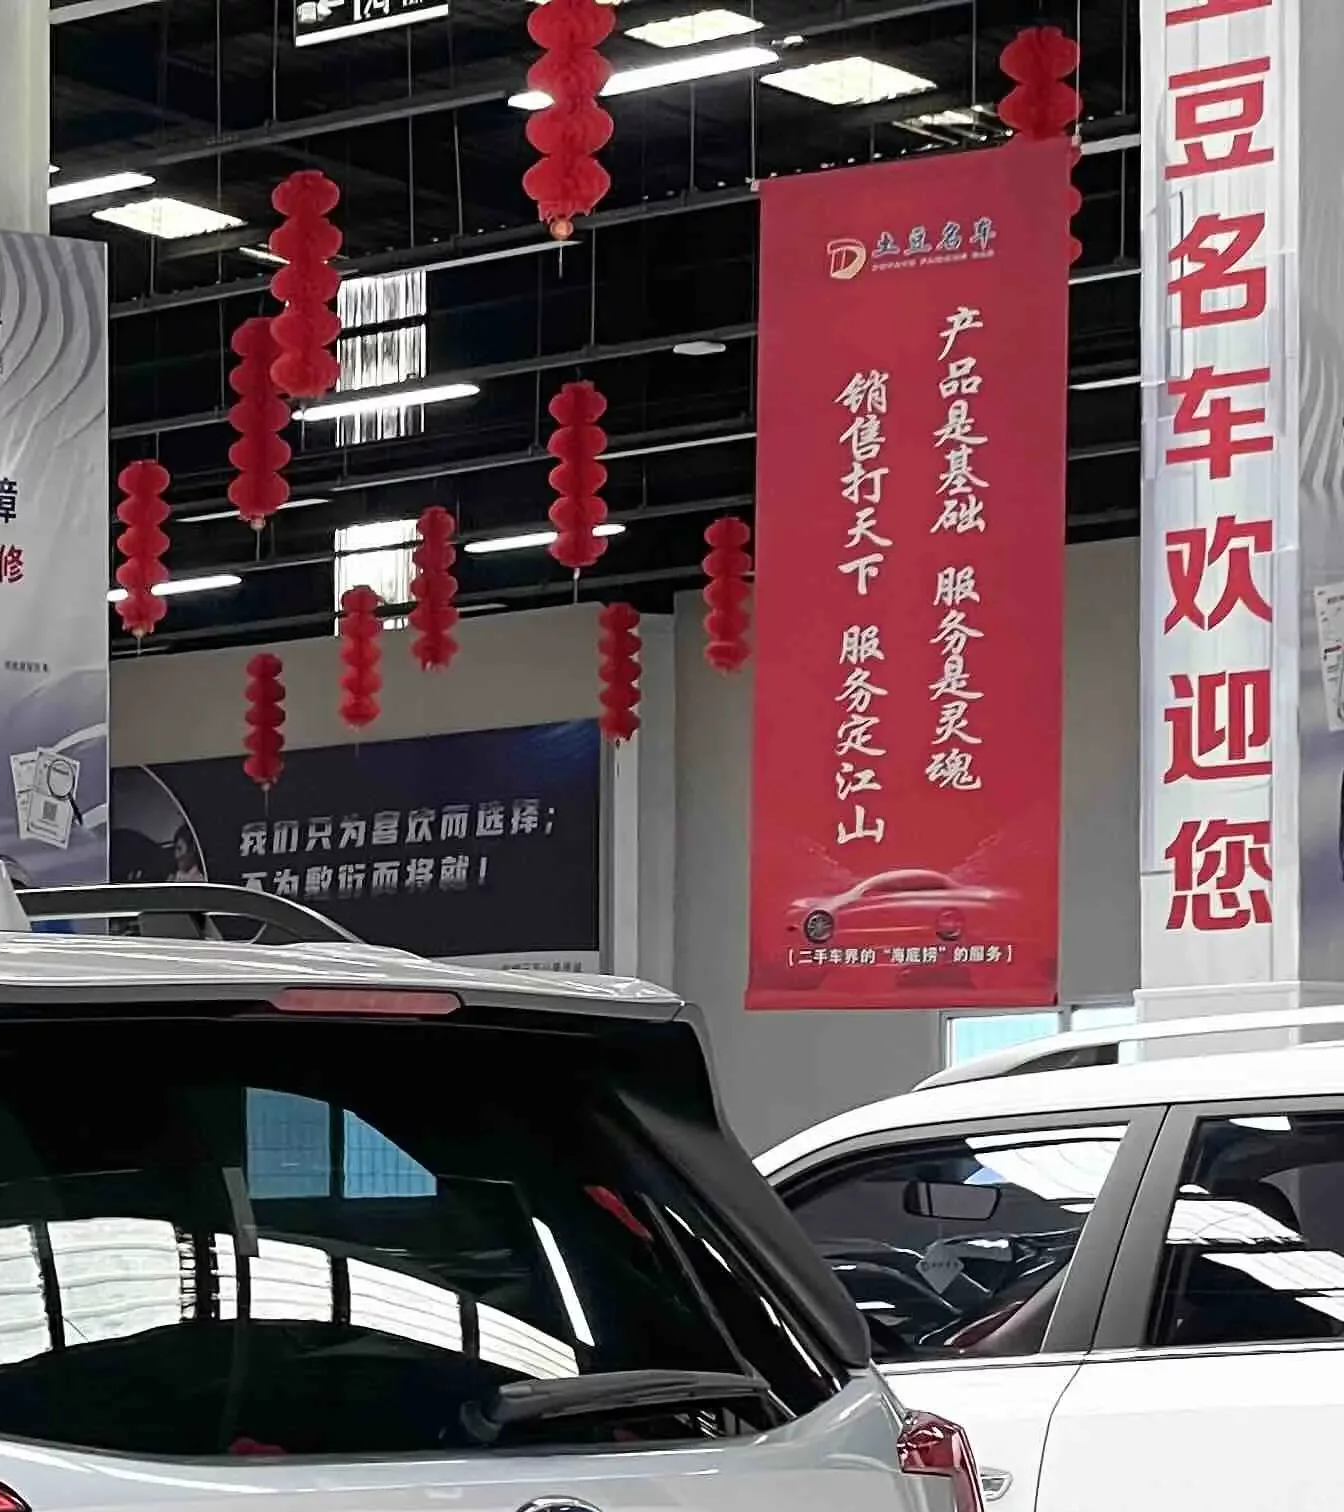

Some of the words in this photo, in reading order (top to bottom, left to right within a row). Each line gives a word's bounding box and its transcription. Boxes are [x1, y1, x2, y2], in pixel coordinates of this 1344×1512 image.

[838, 371, 893, 597] 销售打天下
[932, 304, 989, 536] 产品是基础
[1162, 0, 1276, 933] 豆名车欢迎您
[834, 623, 889, 847] 服务定江山
[924, 565, 984, 792] 服务是灵魂
